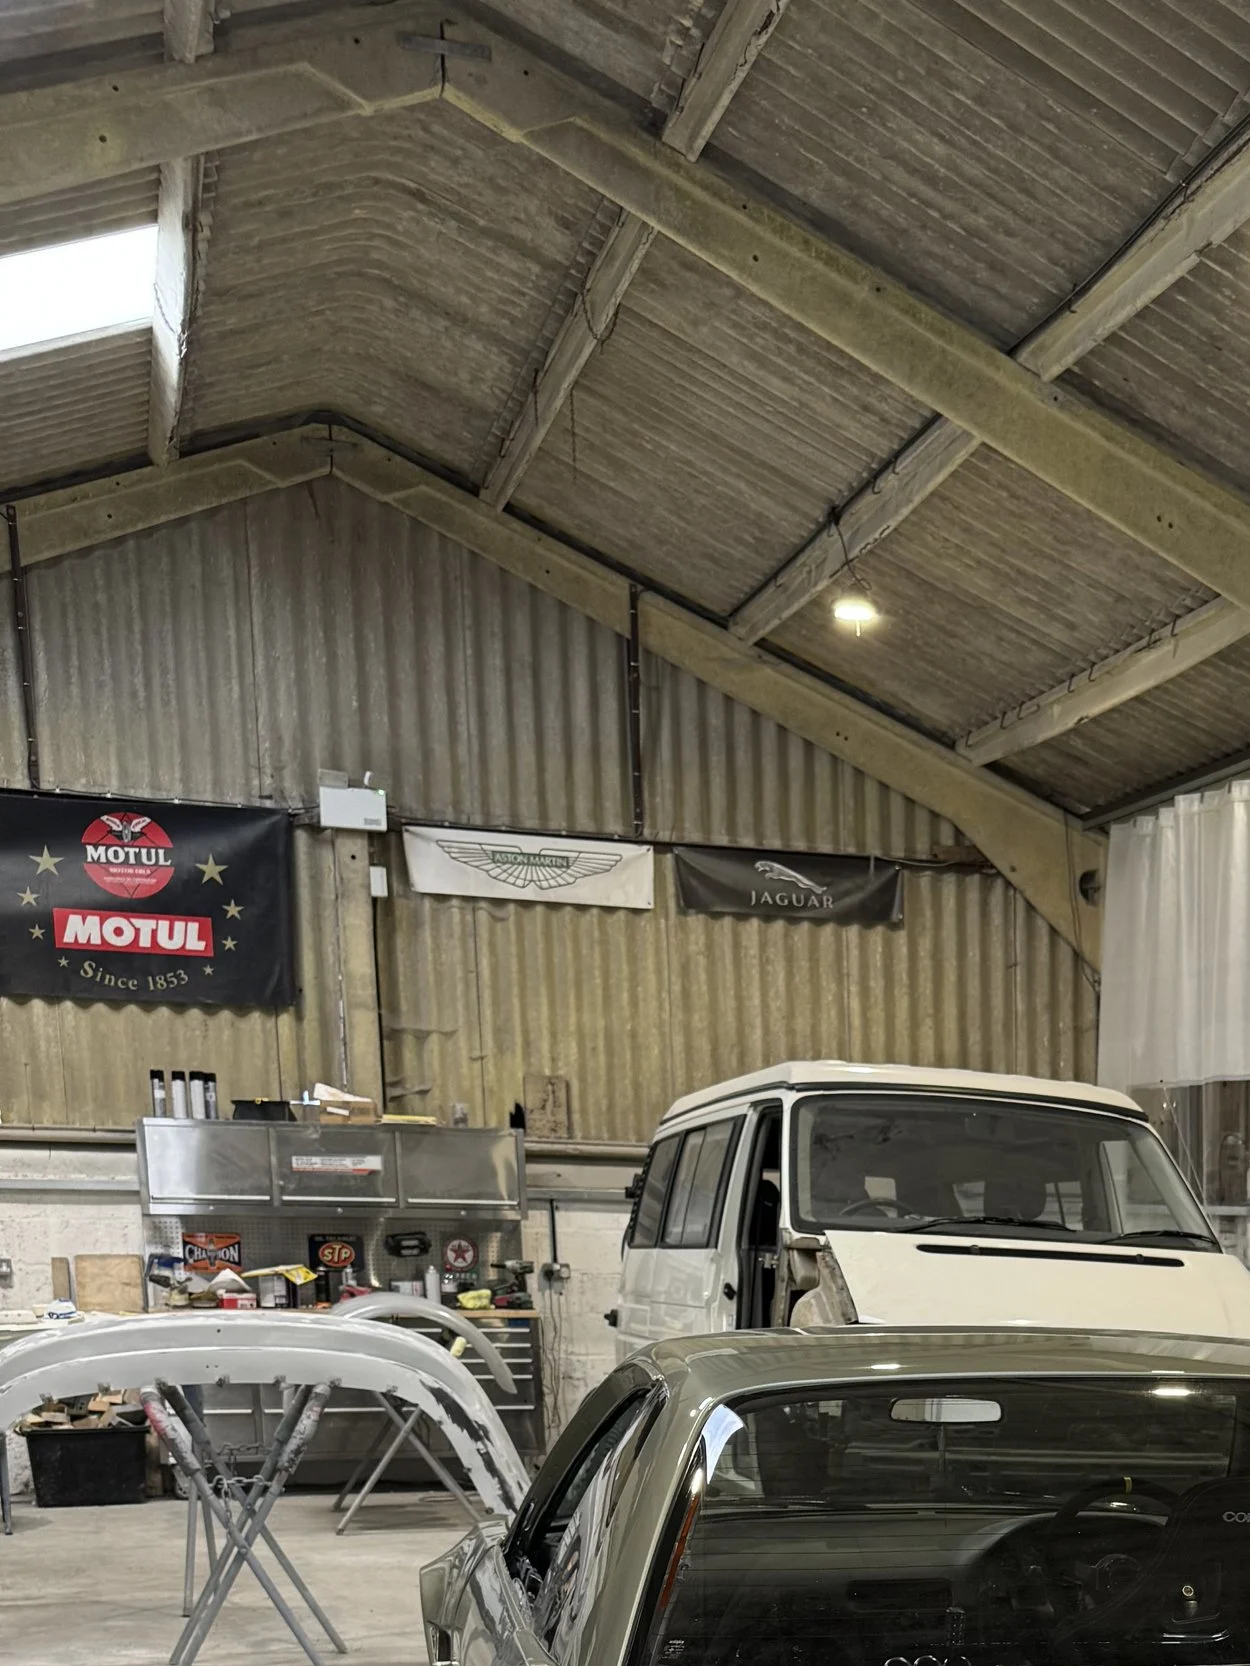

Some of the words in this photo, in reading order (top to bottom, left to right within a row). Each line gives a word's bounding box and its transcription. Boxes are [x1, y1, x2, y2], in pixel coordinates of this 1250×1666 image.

[86, 845, 172, 866] MOTUL
[494, 853, 528, 865] ASTON
[529, 856, 568, 867] MARTIN
[750, 890, 833, 908] JAGUAR
[63, 914, 206, 951] MOTUL
[80, 960, 138, 991] Since
[147, 969, 189, 991] 1853
[185, 1244, 239, 1262] CHAION
[323, 1244, 351, 1262] STP
